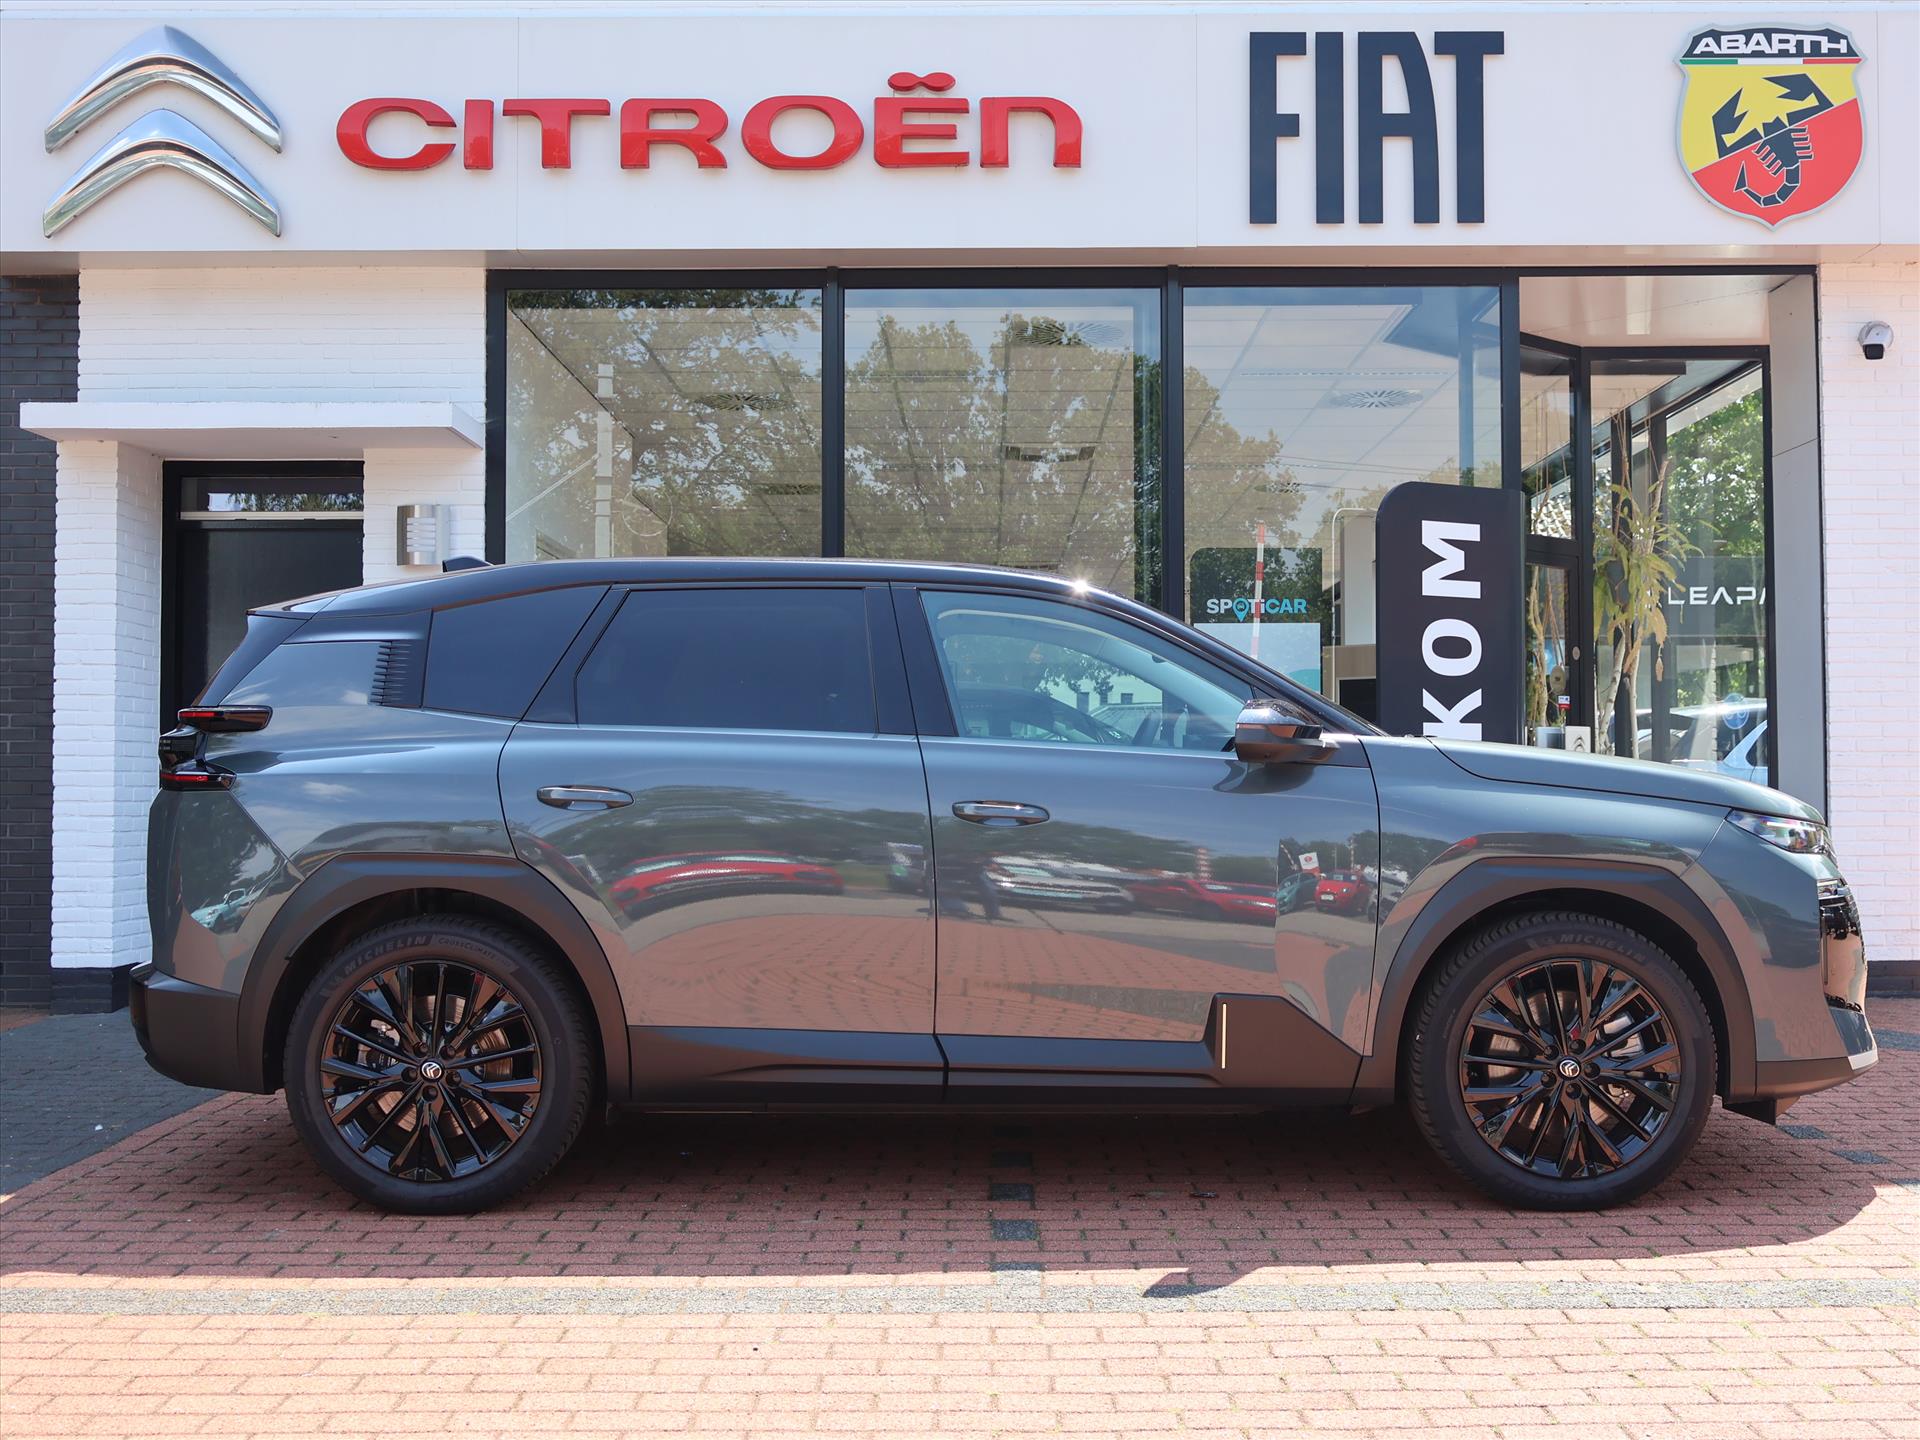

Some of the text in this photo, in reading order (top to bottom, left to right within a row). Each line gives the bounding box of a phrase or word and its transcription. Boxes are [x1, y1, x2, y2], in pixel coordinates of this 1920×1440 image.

[1691, 32, 1849, 56] ABARTH
[1249, 31, 1504, 224] FIAT
[1667, 586, 1767, 606] LEAP
[344, 934, 428, 976] MICHELIN
[1559, 933, 1648, 965] MICHELIN
